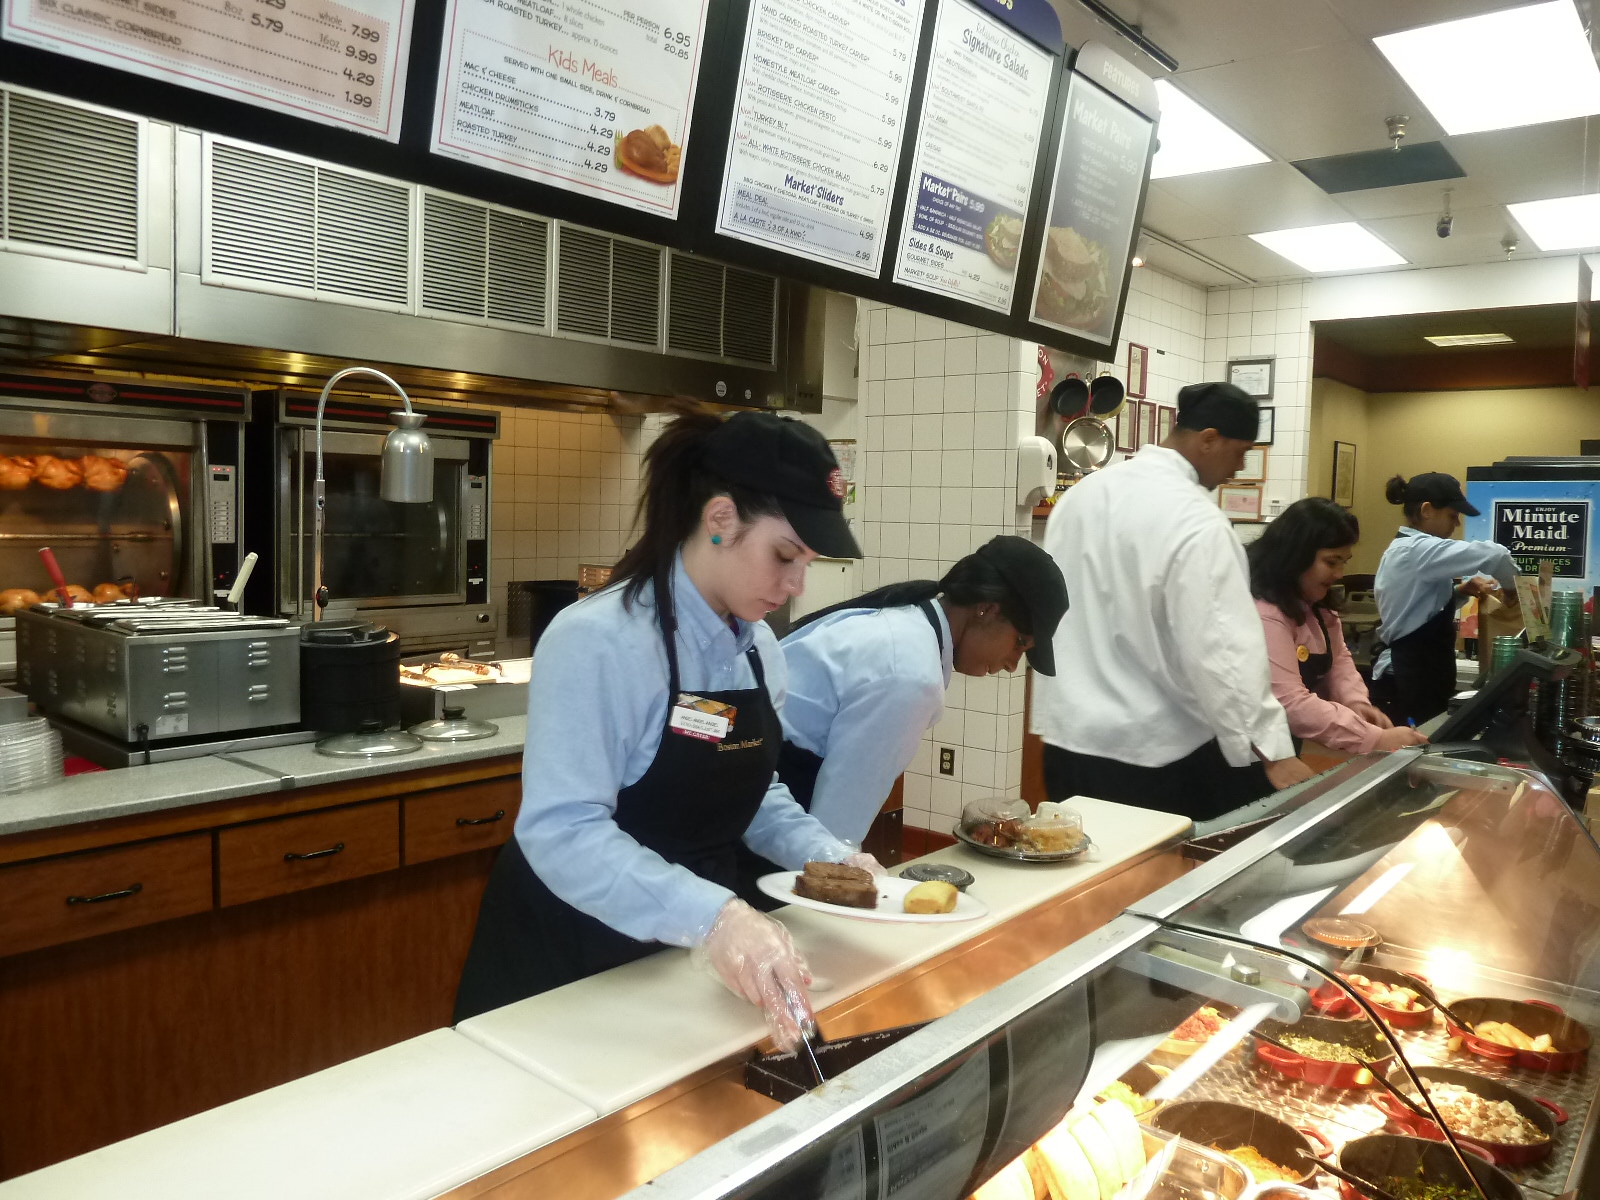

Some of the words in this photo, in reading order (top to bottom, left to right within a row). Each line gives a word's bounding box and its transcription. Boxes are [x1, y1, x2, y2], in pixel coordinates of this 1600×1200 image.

[319, 12, 343, 26] whole
[351, 24, 381, 43] 7.99
[497, 2, 533, 20] ROASTED
[624, 10, 636, 20] PER
[637, 16, 660, 31] PERSON
[664, 27, 691, 47] 6.95
[251, 13, 284, 33] 5.79
[319, 33, 340, 49] 16oz
[345, 45, 378, 65] 9.99
[664, 43, 689, 60] 20.85
[761, 3, 778, 17] HAND
[779, 13, 802, 29] CARVED
[802, 24, 828, 42] ROASTED
[829, 37, 849, 52] TURKEY
[888, 70, 903, 84] 5.99
[892, 48, 907, 62] 5.79
[963, 28, 1002, 65] Signature
[1003, 54, 1029, 81] Salads
[115, 19, 182, 46] CORNBREAD
[345, 90, 373, 108] 1.99
[343, 67, 375, 87] 4.29
[503, 55, 530, 70] SERVED
[530, 64, 545, 76] WITH
[545, 71, 558, 81] ONE
[559, 76, 578, 89] SMALL
[596, 89, 613, 101] DRINK
[619, 98, 651, 115] CORNBREAD
[548, 44, 579, 74] Kids
[582, 58, 618, 89] Meals
[757, 28, 784, 46] BRISKET
[784, 41, 795, 50] DIP
[885, 93, 899, 106] 5.99
[461, 82, 494, 97] CHICKEN
[495, 92, 540, 113] DRUMSTICKS
[590, 123, 614, 139] 4.29
[464, 61, 481, 72] MAC
[488, 70, 517, 85] CHEESE
[594, 106, 616, 122] 3.79
[753, 53, 788, 74] HOMESTYLE
[789, 69, 817, 87] MEATLOAF
[882, 114, 896, 127] 5.99
[459, 100, 495, 117] MEATLOAF
[587, 141, 611, 156] 4.29
[757, 84, 793, 104] ROTISSERIE
[794, 99, 819, 115] CHICKEN
[819, 110, 837, 122] PESTO
[878, 137, 893, 150] 5.99
[456, 119, 491, 135] ROASTED
[492, 129, 518, 143] TURKEY
[584, 158, 608, 173] 4.29
[754, 111, 777, 126] TURKEY
[777, 120, 789, 132] BLT
[874, 161, 889, 173] 6.29
[812, 162, 835, 176] CHICKEN
[870, 184, 885, 197] 5.79
[816, 186, 845, 206] Sliders
[952, 187, 969, 206] Pairs
[969, 199, 986, 213] 5.99
[737, 189, 753, 200] MEAL
[754, 194, 769, 205] DEAL
[859, 229, 874, 241] 4.99
[740, 213, 747, 221] LA
[748, 216, 767, 227] CARTE
[855, 250, 871, 261] 2.99
[907, 252, 930, 264] GOURMET
[930, 260, 945, 269] SIDES
[908, 237, 928, 252] Sides
[928, 243, 935, 253] &
[936, 246, 954, 261] Soups
[1503, 507, 1580, 523] Minute
[1512, 524, 1569, 540] Maid
[1511, 541, 1567, 552] Premium
